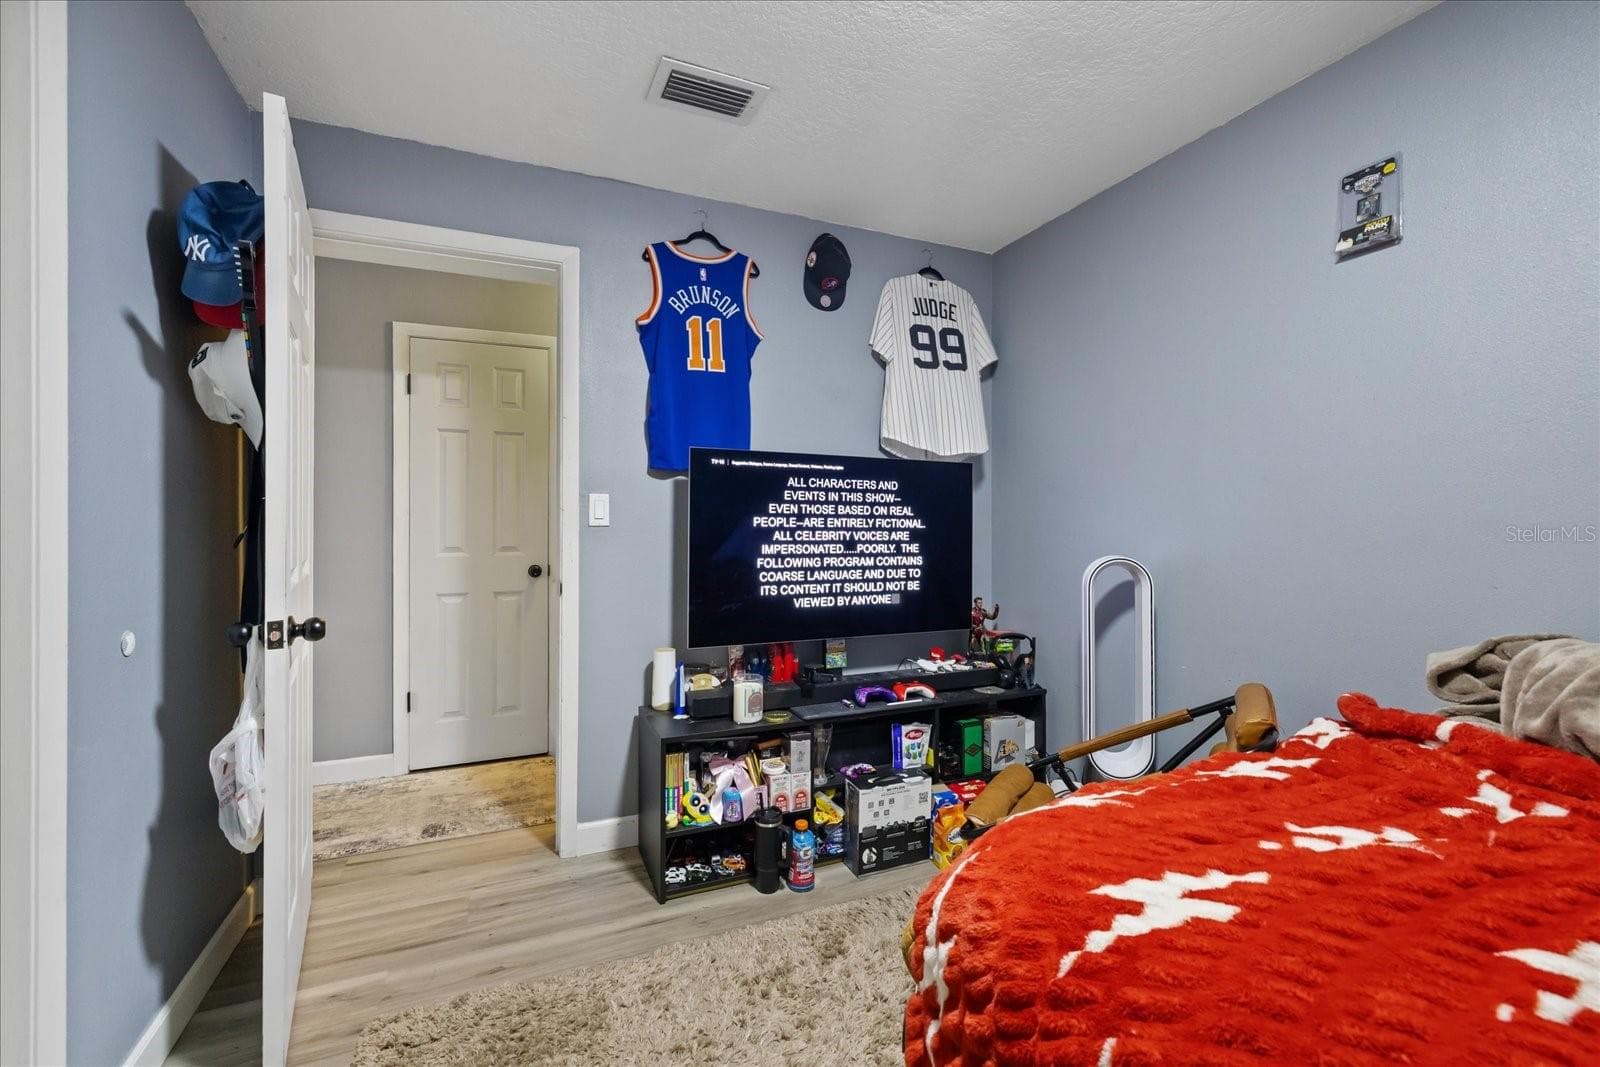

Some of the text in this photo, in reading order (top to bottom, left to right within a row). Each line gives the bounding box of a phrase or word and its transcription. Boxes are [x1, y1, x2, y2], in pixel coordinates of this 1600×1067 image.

[668, 285, 740, 319] BRUNSON
[912, 297, 957, 322] JUDGE
[686, 315, 726, 373] 11
[909, 324, 968, 372] 99
[787, 477, 898, 490] ALL CHARACTERS AND
[784, 491, 826, 501] EVENTS
[828, 492, 838, 501] IN
[841, 492, 862, 502] THIS
[769, 504, 914, 516] EVEN THOSE BASED ON REAL
[827, 518, 874, 528] ENTIRELY
[876, 519, 925, 528] FICTIONAL.
[773, 531, 910, 541] ALL CELEBRITY VOICES ARE
[901, 544, 919, 552] THE
[757, 556, 923, 568] FOLLOWING PROGRAM CONTAINS
[759, 569, 921, 582] COARSE LANGUAGE AND DUE TO
[761, 581, 920, 596] ITS CONTENT IT SHOULD NOT BE
[794, 594, 892, 608] VIEWED BY ANYONE
